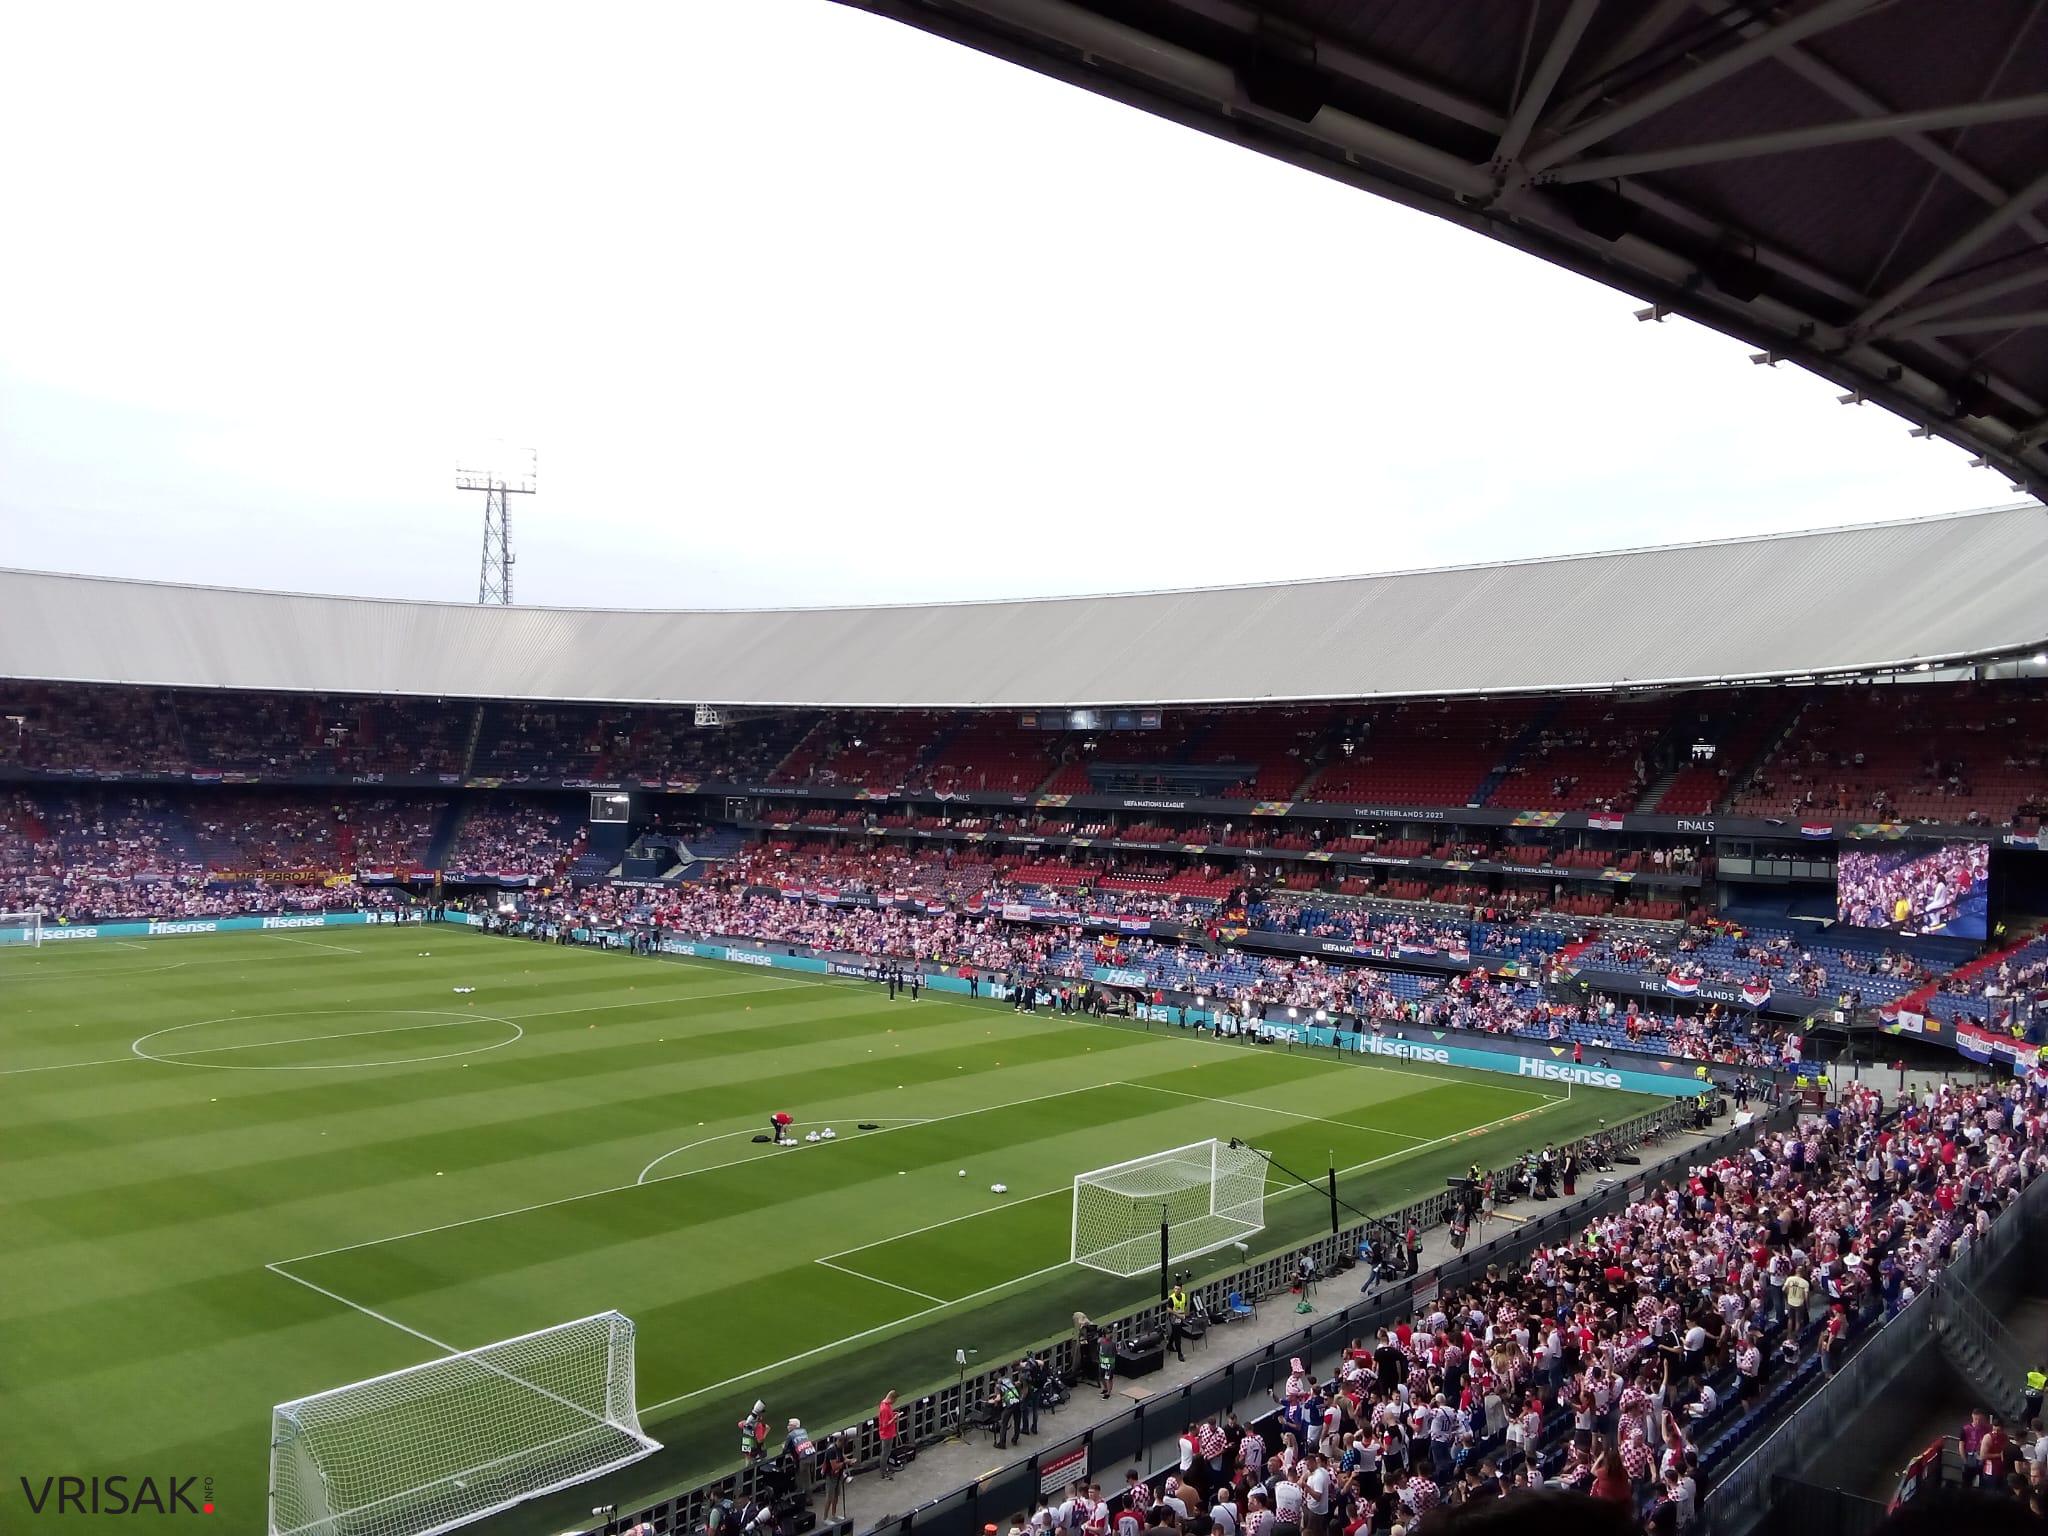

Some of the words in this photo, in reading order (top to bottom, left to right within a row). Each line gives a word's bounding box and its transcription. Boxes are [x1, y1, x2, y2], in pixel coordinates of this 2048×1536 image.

[1370, 809, 1423, 818] NETHERLANDS
[1677, 820, 1715, 832] FINALS
[149, 922, 217, 935] Hisense
[262, 916, 325, 929] Hisense
[1322, 943, 1339, 952] UEFA
[1371, 948, 1400, 959] LEAUE
[725, 947, 772, 966] Hisense
[1640, 980, 1659, 991] THE
[1360, 1034, 1449, 1064] Hisense
[1519, 1056, 1622, 1089] Hisense
[1253, 1449, 1259, 1463] 7
